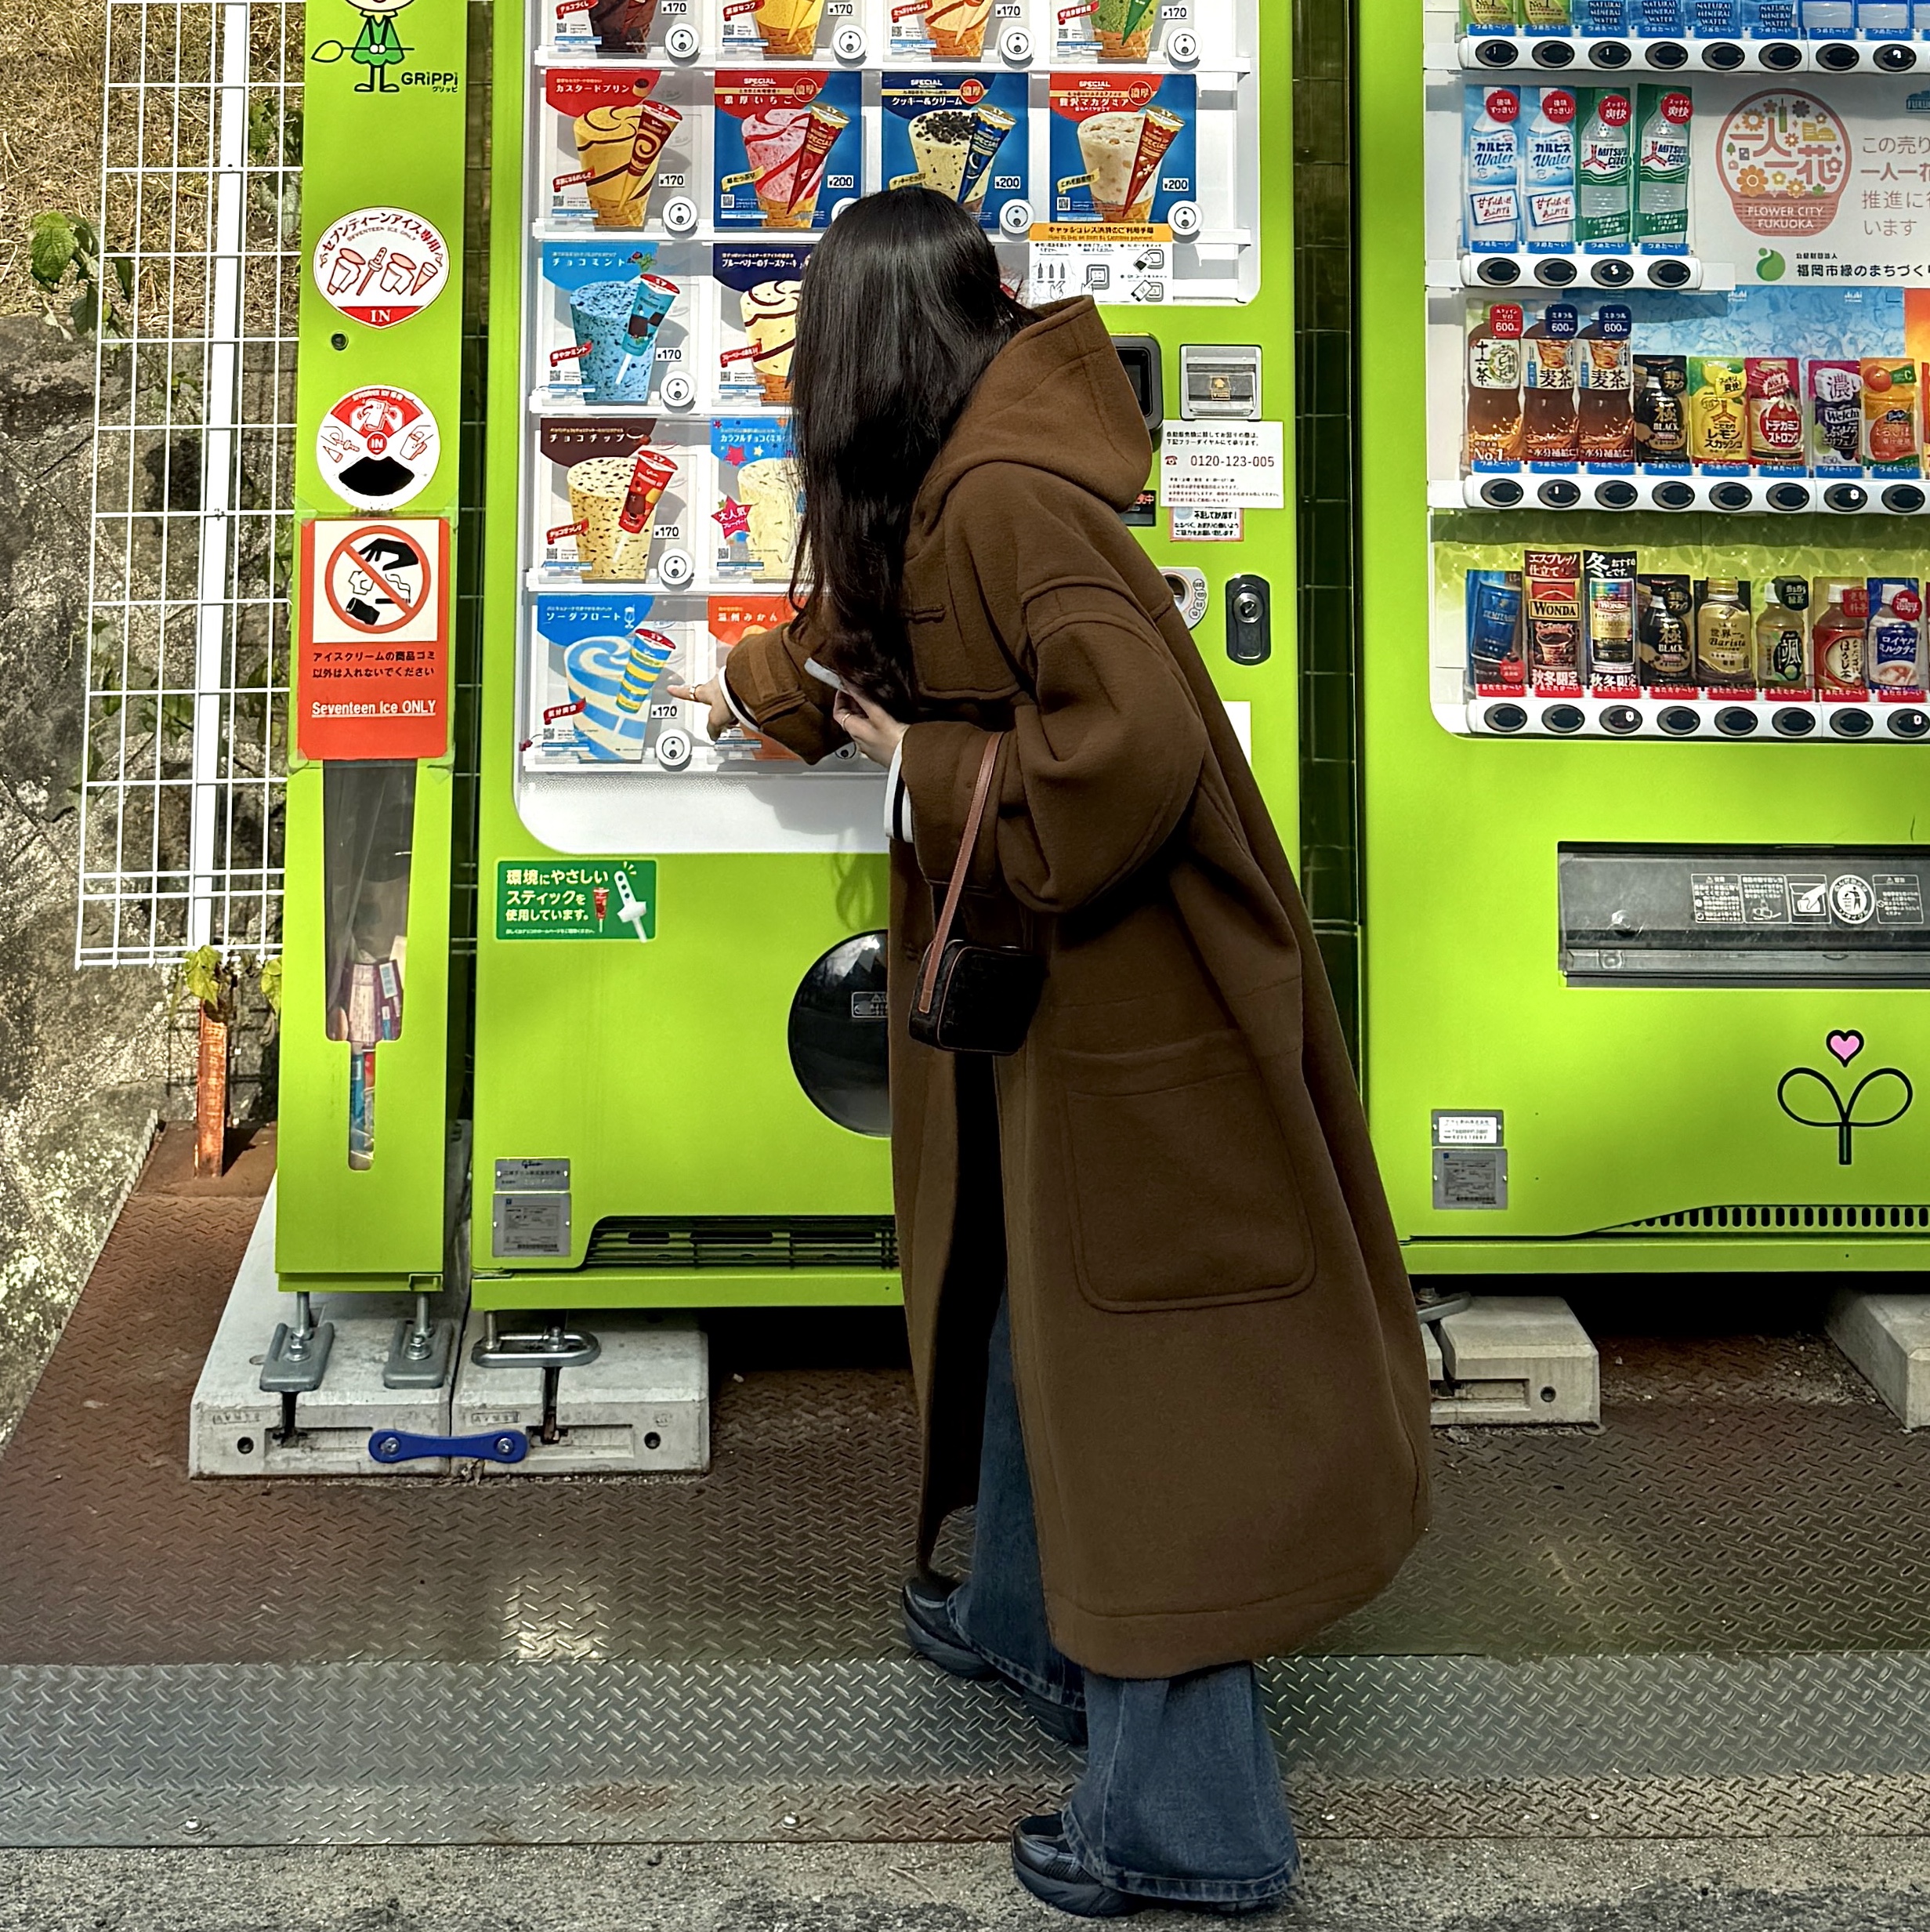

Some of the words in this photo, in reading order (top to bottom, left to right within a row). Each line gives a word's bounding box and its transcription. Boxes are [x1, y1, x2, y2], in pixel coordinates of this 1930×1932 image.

[556, 84, 630, 93] カスタードプリン
[724, 96, 793, 104] 濃厚いちご
[892, 97, 962, 106] クッキー&クリーム
[1606, 109, 1627, 119] 爽快
[1667, 107, 1689, 118] 爽快
[1477, 143, 1513, 152] カルピス
[1536, 143, 1571, 153] カルピス
[1475, 153, 1514, 166] Water
[1533, 154, 1572, 167] Water
[1748, 206, 1794, 217] FLOWER
[1798, 206, 1823, 217] CITY
[1758, 219, 1814, 229] FUKUOKA
[1863, 219, 1917, 236] います
[322, 212, 441, 252] セブンティーンアイス専用
[552, 258, 625, 266] チョコミント
[1797, 264, 1930, 277] 福岡市緑のまちづく
[370, 310, 391, 322] IN
[1475, 341, 1492, 386] 十六茶
[1540, 368, 1572, 388] 麦茶
[1591, 369, 1627, 389] 麦茶
[1904, 371, 1912, 381] C
[550, 434, 625, 443] チョコチップ
[1707, 429, 1740, 439] レモン
[1769, 433, 1799, 443] ストロング
[371, 438, 383, 449] IN
[1704, 439, 1743, 448] スカッシュ
[1475, 448, 1503, 461] No.1
[1190, 455, 1275, 467] 0120-123-005
[719, 506, 748, 521] 大人気
[1529, 553, 1577, 564] エスプレッソ
[1585, 553, 1610, 578] 冬
[1533, 602, 1577, 616] WONDA
[546, 612, 621, 621] ソーダフロート
[718, 613, 778, 622] 温州みかん
[1709, 638, 1746, 647] Barista
[313, 666, 435, 679] 以外は入れないでください
[1531, 669, 1577, 686] 秋冬限定
[1590, 672, 1637, 687] 秋冬限定
[312, 701, 376, 716] Seventeen
[379, 700, 398, 714] Ice
[402, 699, 436, 713] ONLY
[505, 869, 608, 885] 環境にやさしい
[506, 890, 586, 905] スティックを
[505, 909, 589, 921] 使用しています。
